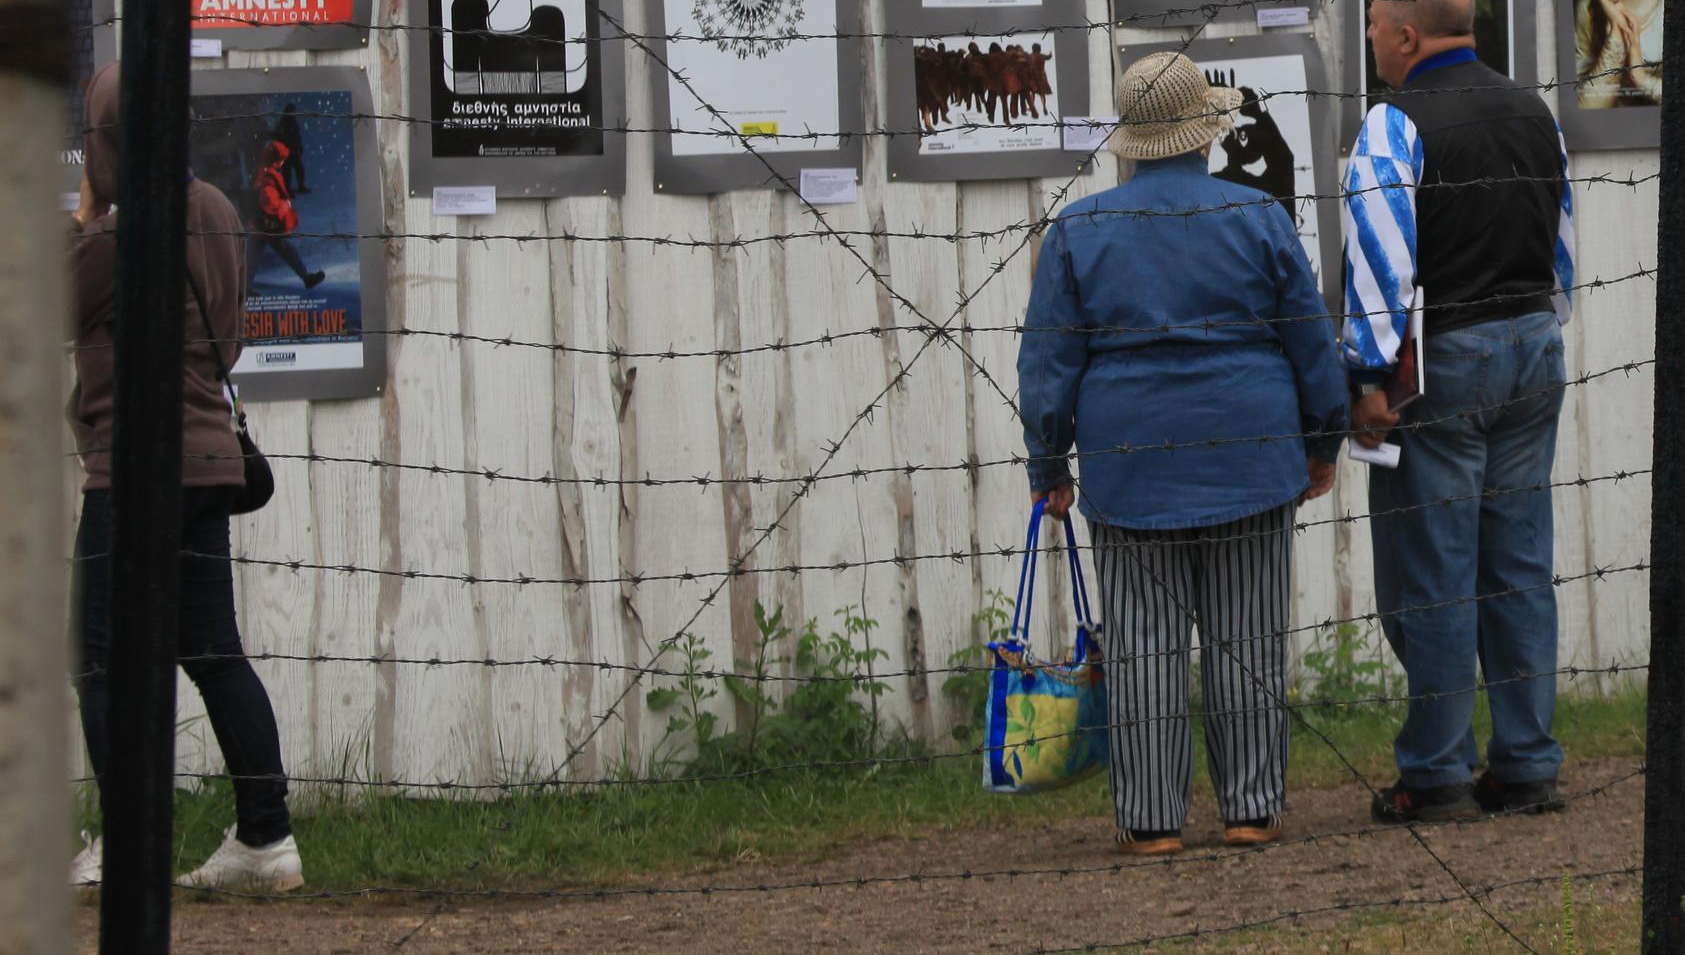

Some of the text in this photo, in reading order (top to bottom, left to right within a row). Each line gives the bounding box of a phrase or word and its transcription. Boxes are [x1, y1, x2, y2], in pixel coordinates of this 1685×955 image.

[200, 11, 329, 23] INTERNATIONAL
[452, 101, 582, 117] διεθνής αμνηστία
[443, 114, 590, 131] amnesty international
[278, 309, 309, 336] WITH
[313, 308, 347, 335] LOVE
